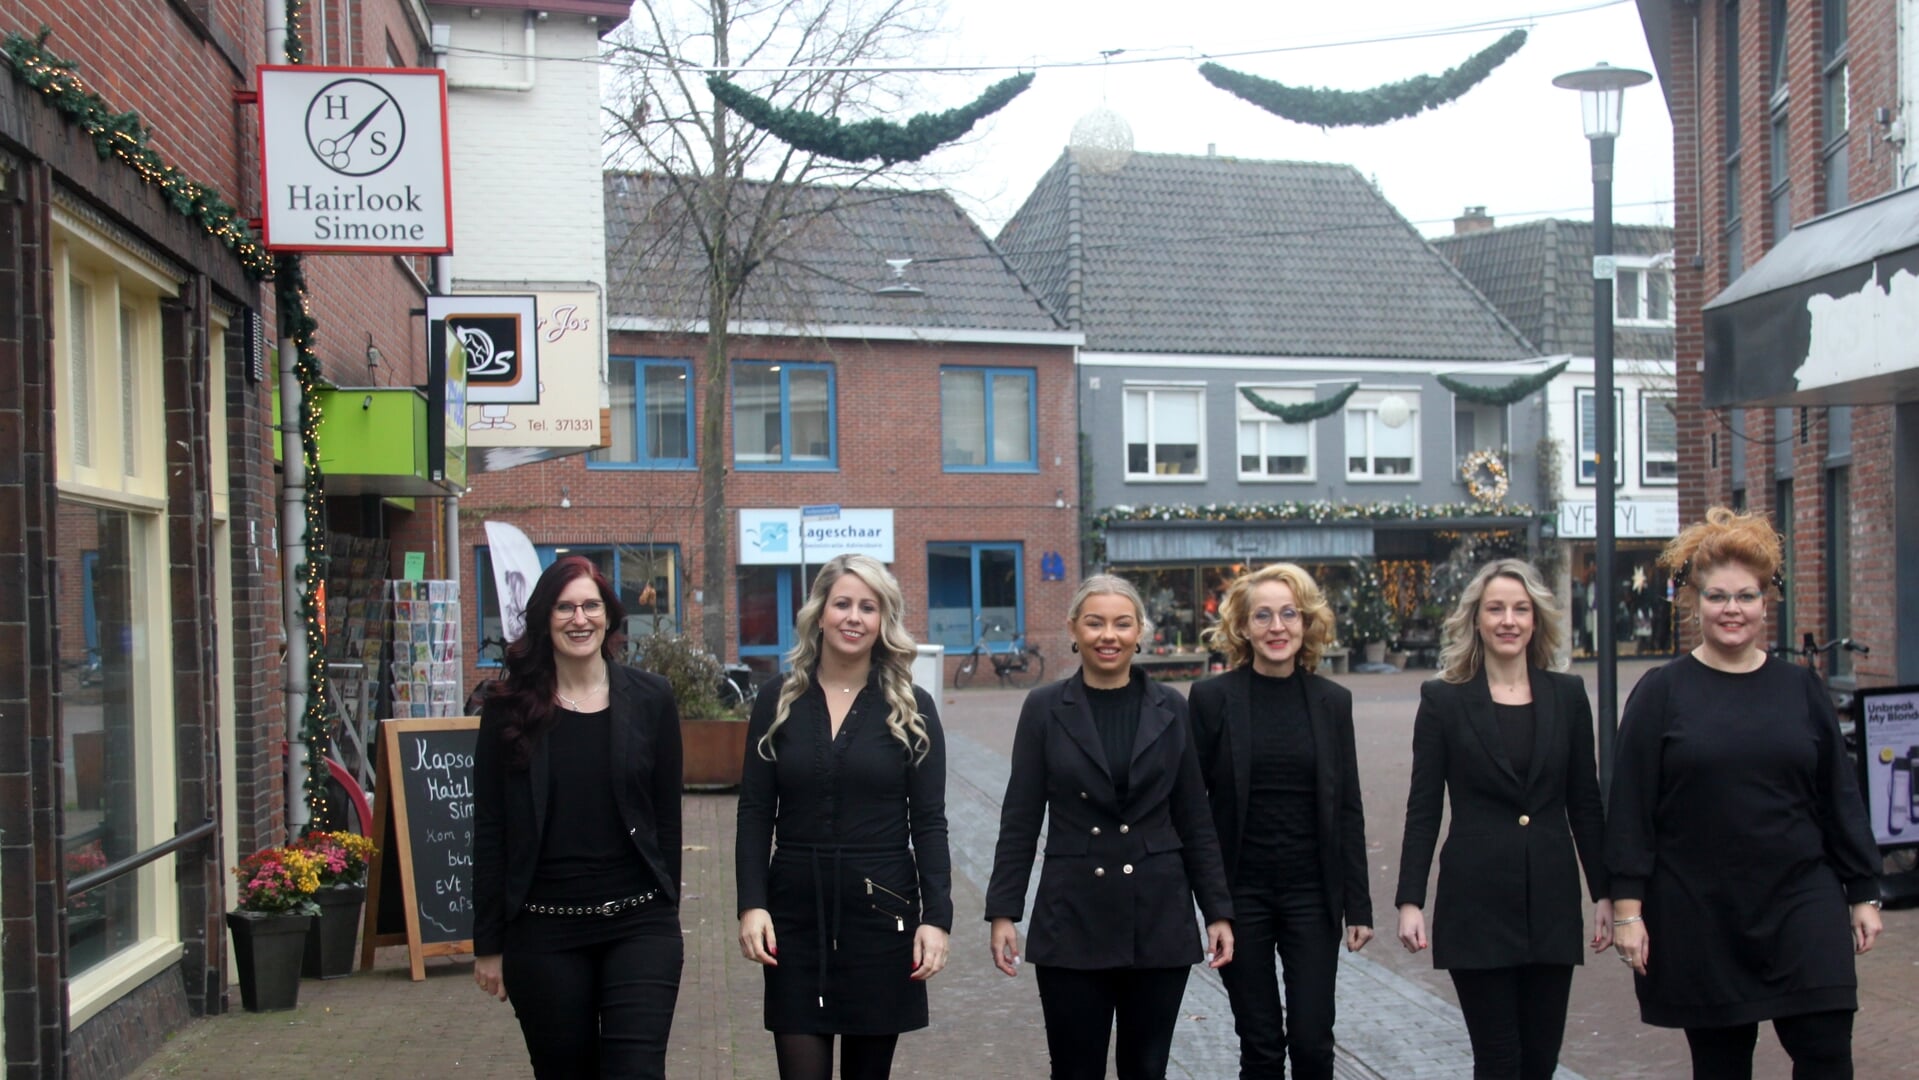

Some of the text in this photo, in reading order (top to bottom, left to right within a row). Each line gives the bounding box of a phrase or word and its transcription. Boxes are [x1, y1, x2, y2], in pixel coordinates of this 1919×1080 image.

[325, 95, 349, 120] H
[370, 131, 387, 156] S
[287, 184, 423, 212] Hairlook
[314, 215, 424, 241] Simone
[545, 304, 590, 343] Jos
[528, 419, 593, 431] Tel. 371331
[1868, 702, 1914, 713] Unbreak
[1869, 711, 1919, 725] My Blond
[410, 738, 475, 779] Kapsa
[449, 801, 475, 820] Sim
[448, 849, 474, 866] bin
[449, 896, 473, 912] afs
